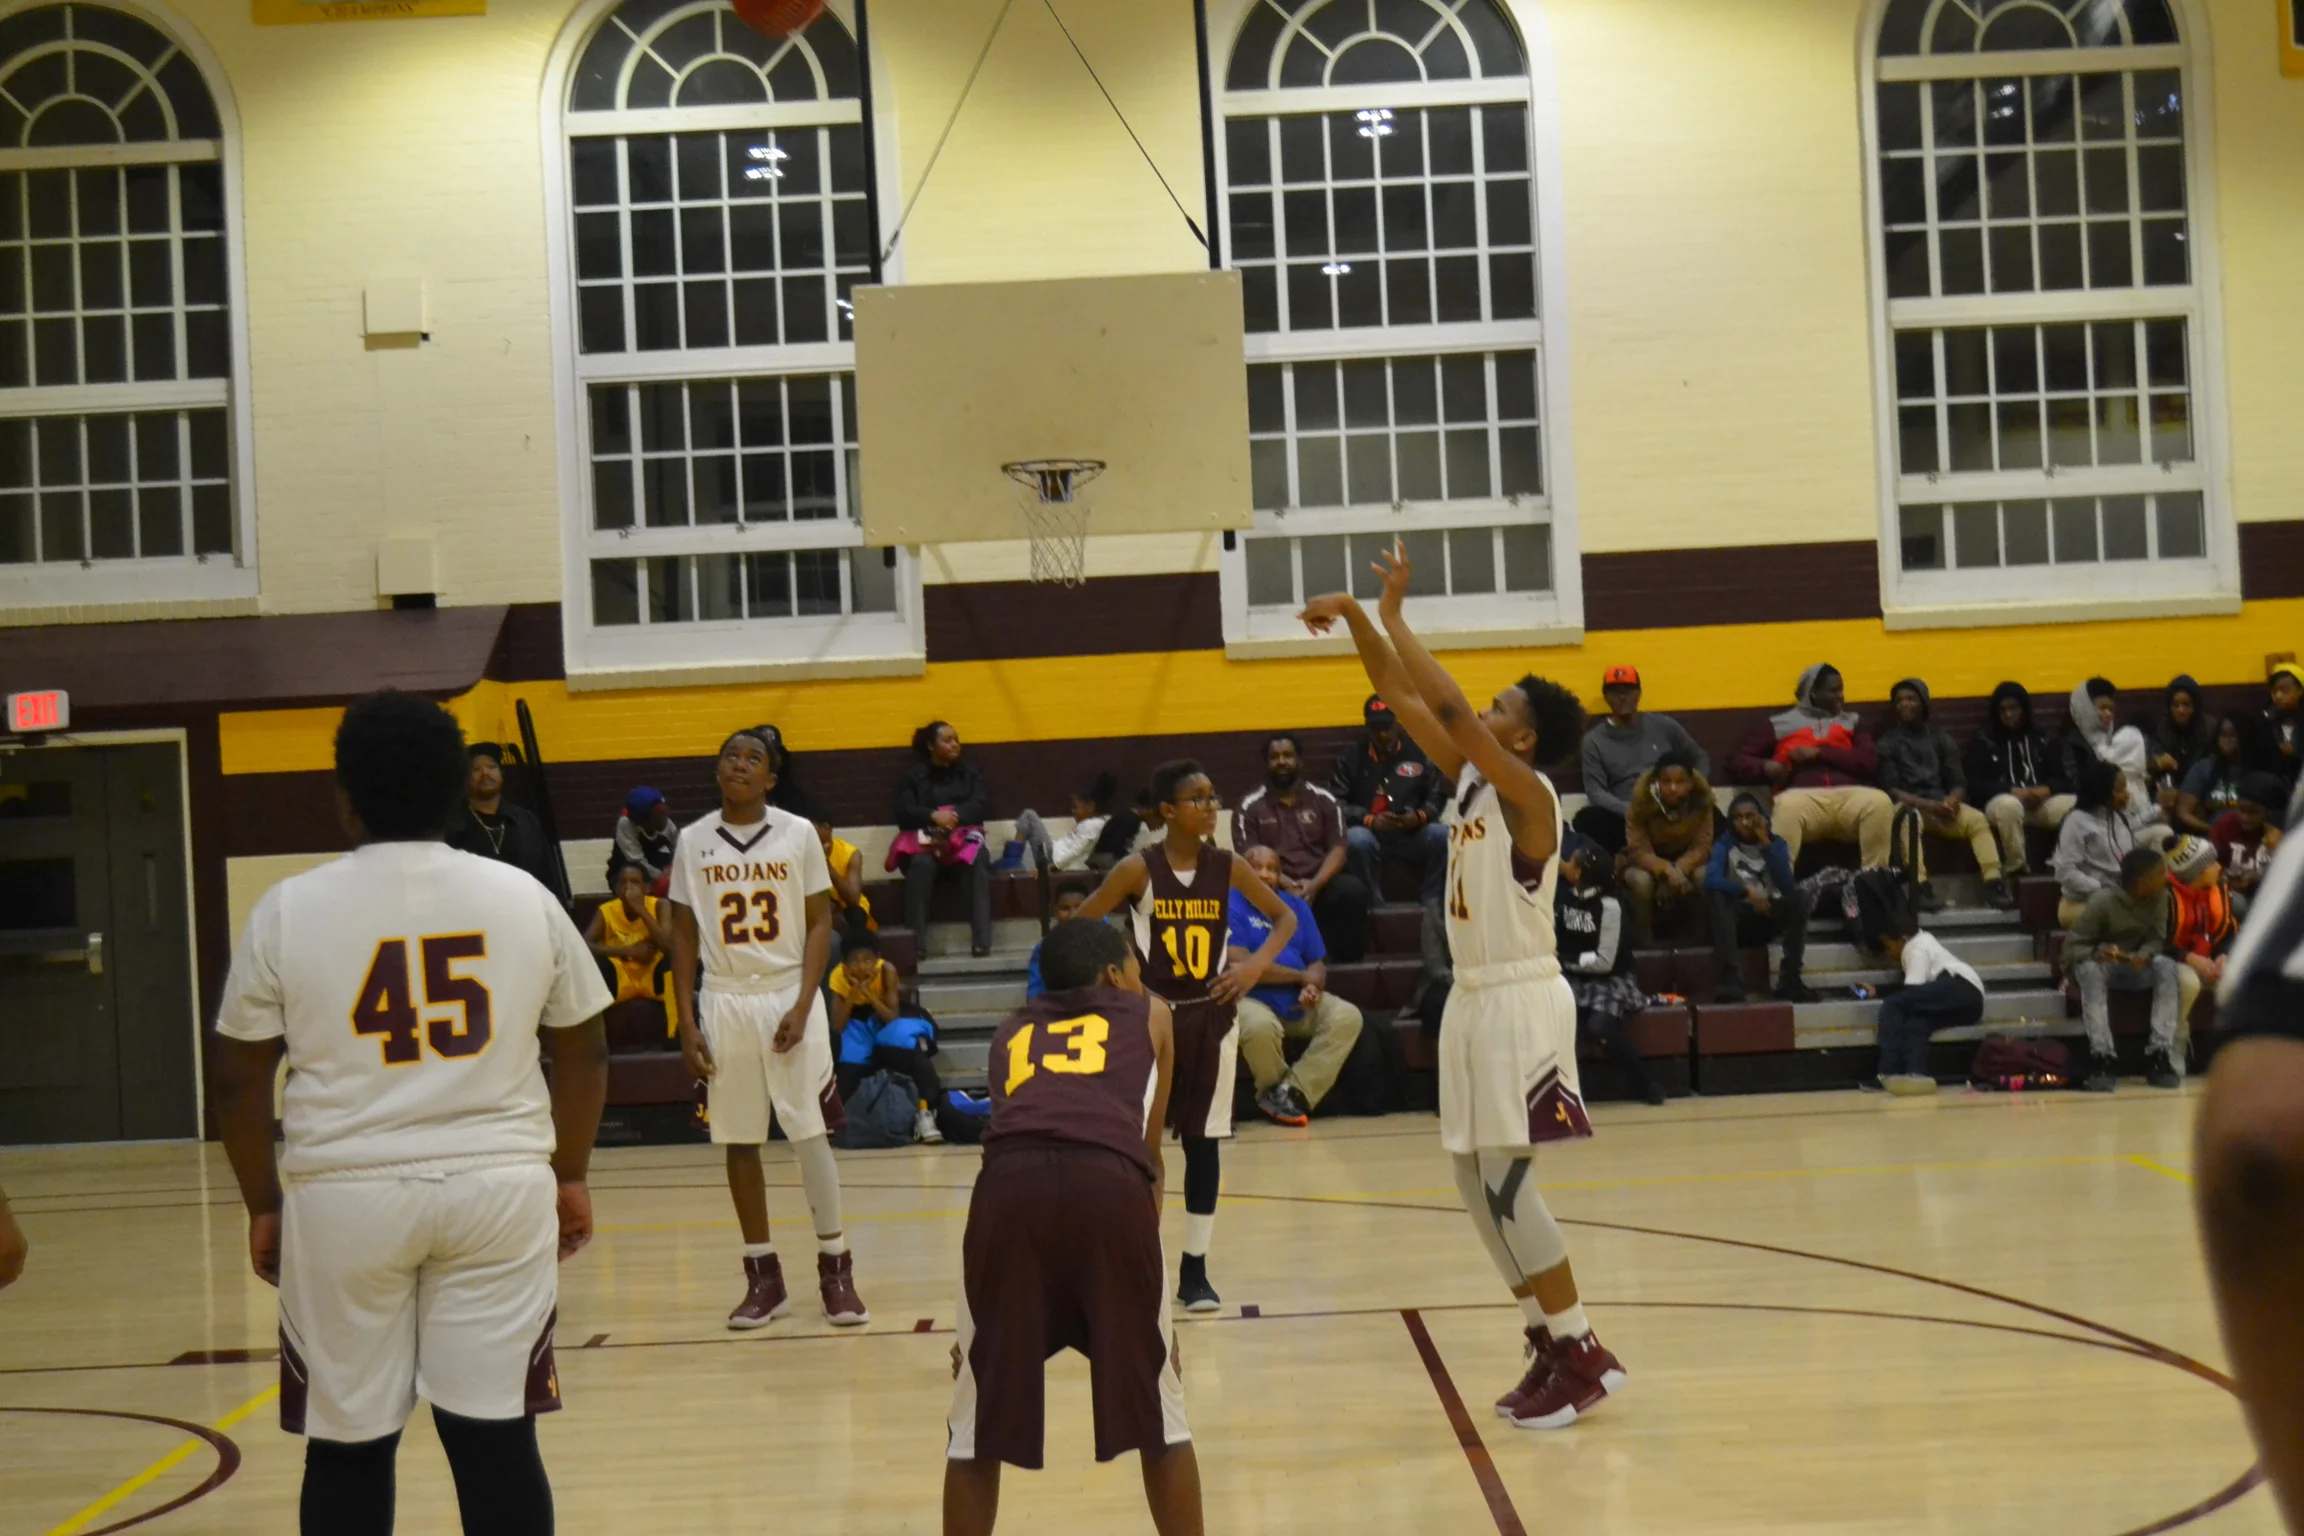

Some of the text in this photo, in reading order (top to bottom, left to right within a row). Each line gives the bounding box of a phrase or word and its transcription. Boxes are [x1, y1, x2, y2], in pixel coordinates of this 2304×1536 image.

[16, 692, 59, 728] EXIT
[701, 861, 788, 885] TROJANS
[718, 889, 780, 946] 23
[1154, 898, 1220, 920] ELLY MILLER
[1161, 924, 1211, 980] 10
[348, 929, 494, 1068] 45
[1004, 1013, 1109, 1097] 13
